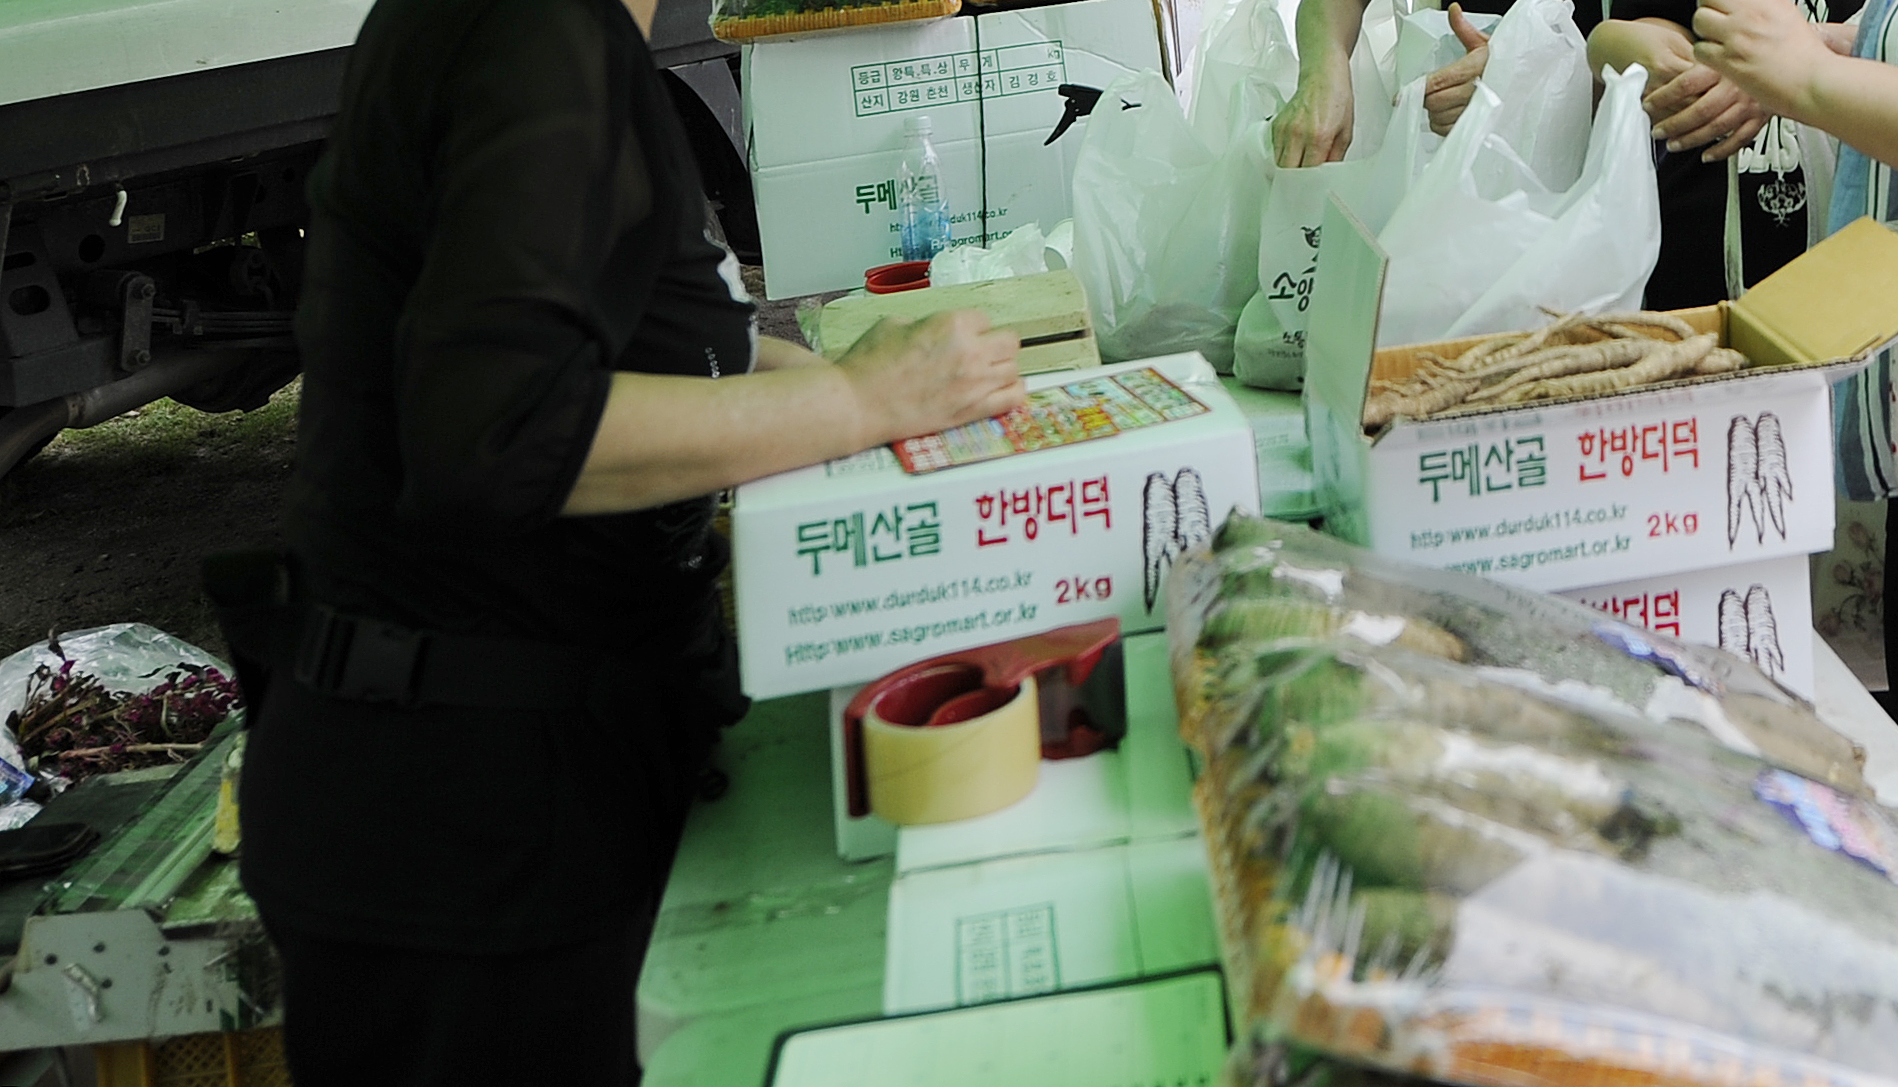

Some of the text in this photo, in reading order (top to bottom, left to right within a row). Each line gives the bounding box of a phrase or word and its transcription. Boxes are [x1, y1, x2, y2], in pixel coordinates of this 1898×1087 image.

[858, 69, 881, 85] 등급
[1047, 48, 1061, 61] kg
[861, 94, 884, 109] 산지
[897, 88, 920, 105] 강원
[926, 85, 949, 100] 춘천
[1419, 435, 1547, 503] 두메산골
[1577, 416, 1699, 482] 한방더덕
[797, 475, 1112, 577] 두메산골 한방더덕
[1647, 512, 1699, 538] 2kg
[1055, 576, 1114, 606] 2kg
